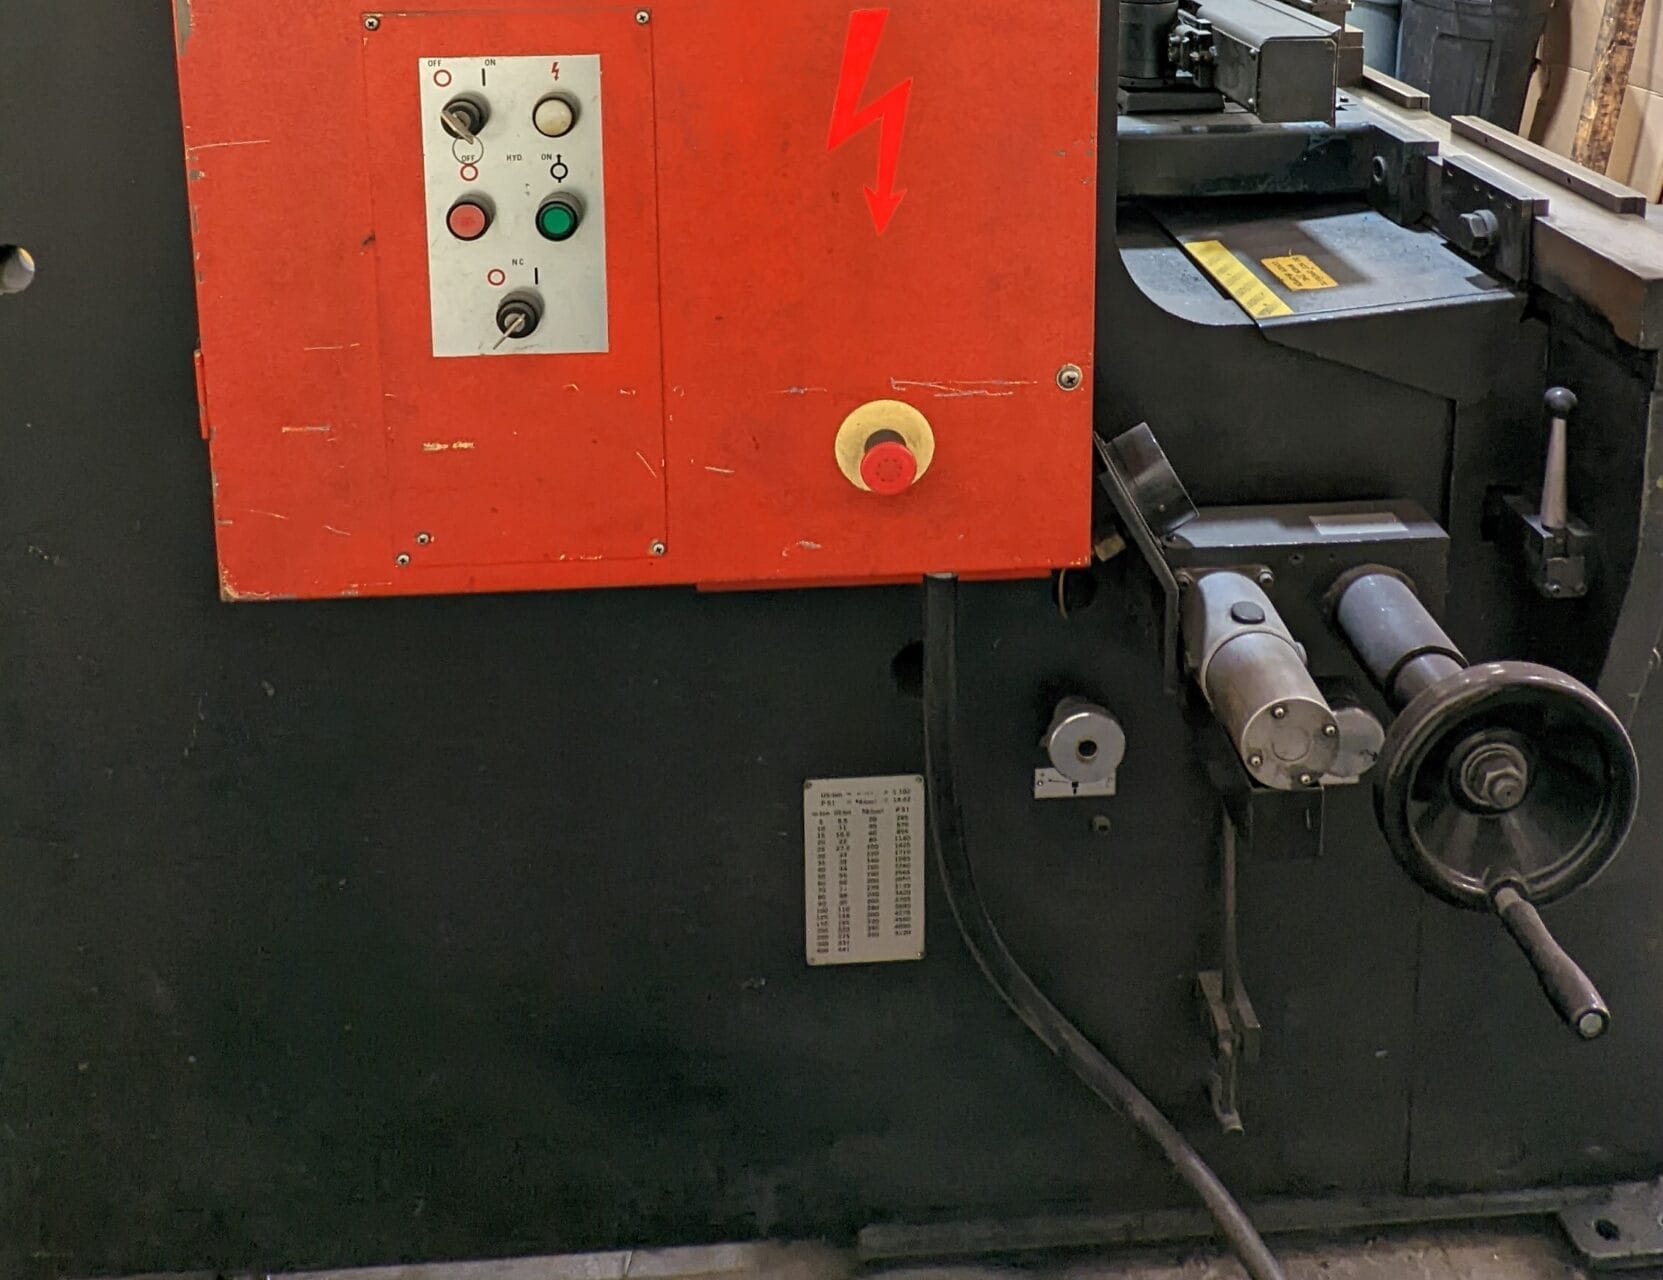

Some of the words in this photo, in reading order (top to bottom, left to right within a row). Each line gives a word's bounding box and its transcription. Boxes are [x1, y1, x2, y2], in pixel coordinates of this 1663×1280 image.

[427, 59, 442, 67] OFF
[484, 58, 497, 66] ON
[461, 154, 476, 162] OFF
[506, 153, 523, 162] HYD
[541, 153, 553, 161] ON
